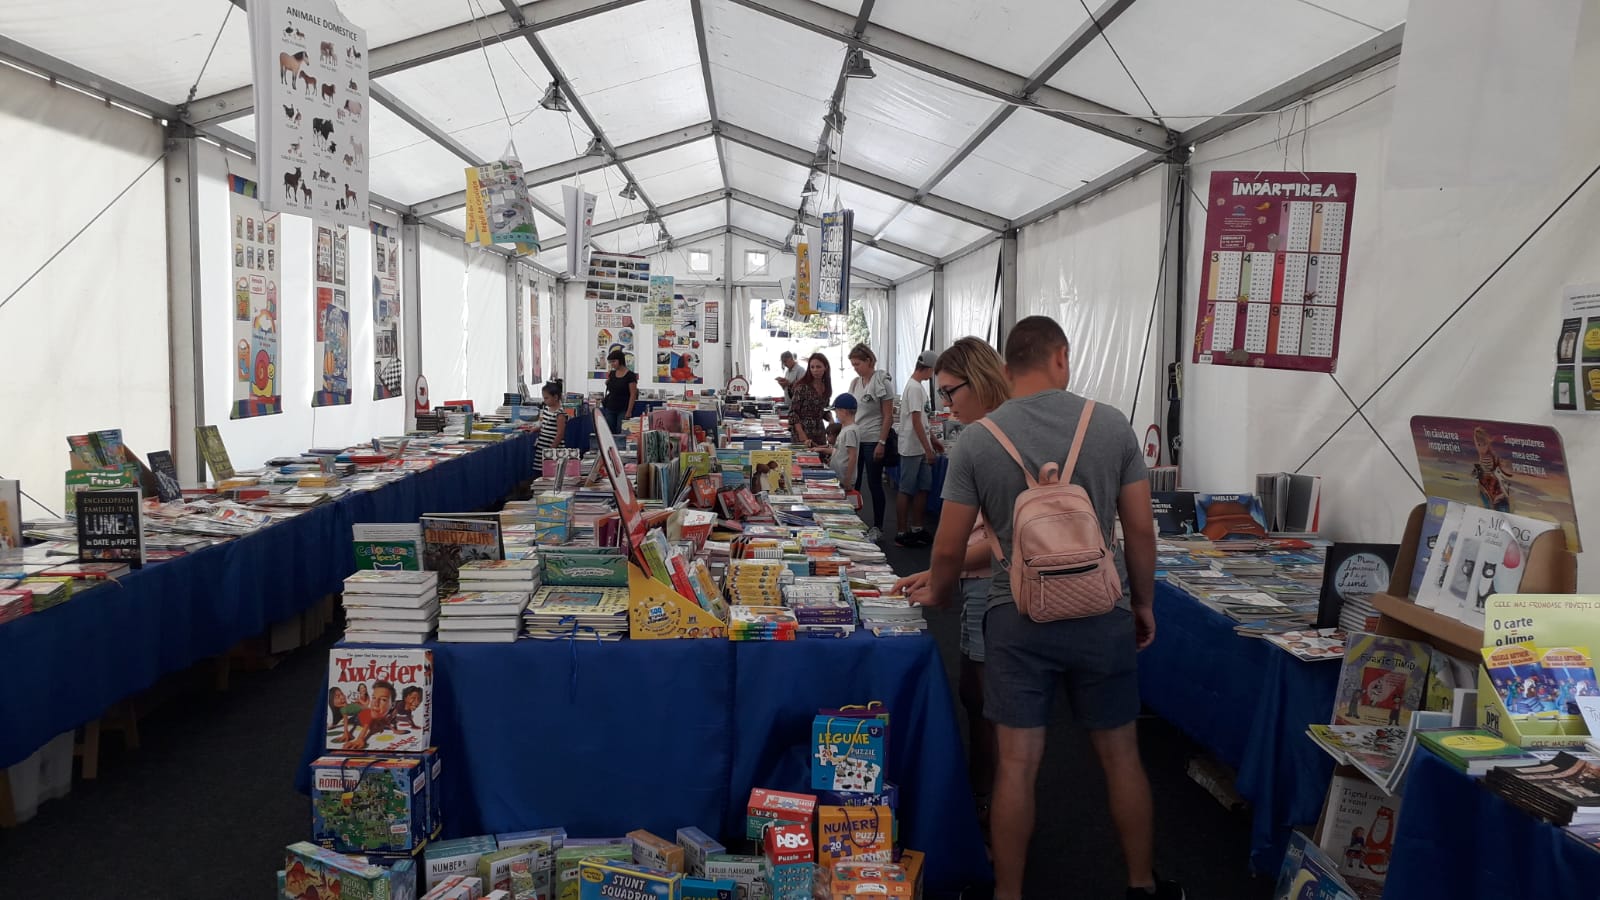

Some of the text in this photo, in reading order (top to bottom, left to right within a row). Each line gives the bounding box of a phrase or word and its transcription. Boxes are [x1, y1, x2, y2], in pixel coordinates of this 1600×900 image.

[286, 6, 358, 41] ANIMALE DOMESTICE
[1283, 203, 1323, 213] 1 2
[1212, 253, 1318, 266] 3 4 5 6
[1208, 304, 1314, 318] 7 8 9 10
[85, 514, 136, 535] LUMEA
[1504, 618, 1533, 629] carte
[1496, 634, 1534, 646] o lume
[336, 657, 423, 683] Twister
[422, 690, 431, 735] Twister
[1486, 711, 1499, 730] DPH
[818, 733, 870, 744] LEGUME
[751, 808, 778, 818] Puzzle
[824, 819, 877, 833] NUMERE
[776, 833, 809, 849] ABC
[830, 841, 842, 850] 20
[432, 860, 467, 873] NUMBERS
[612, 874, 646, 891] STUNT
